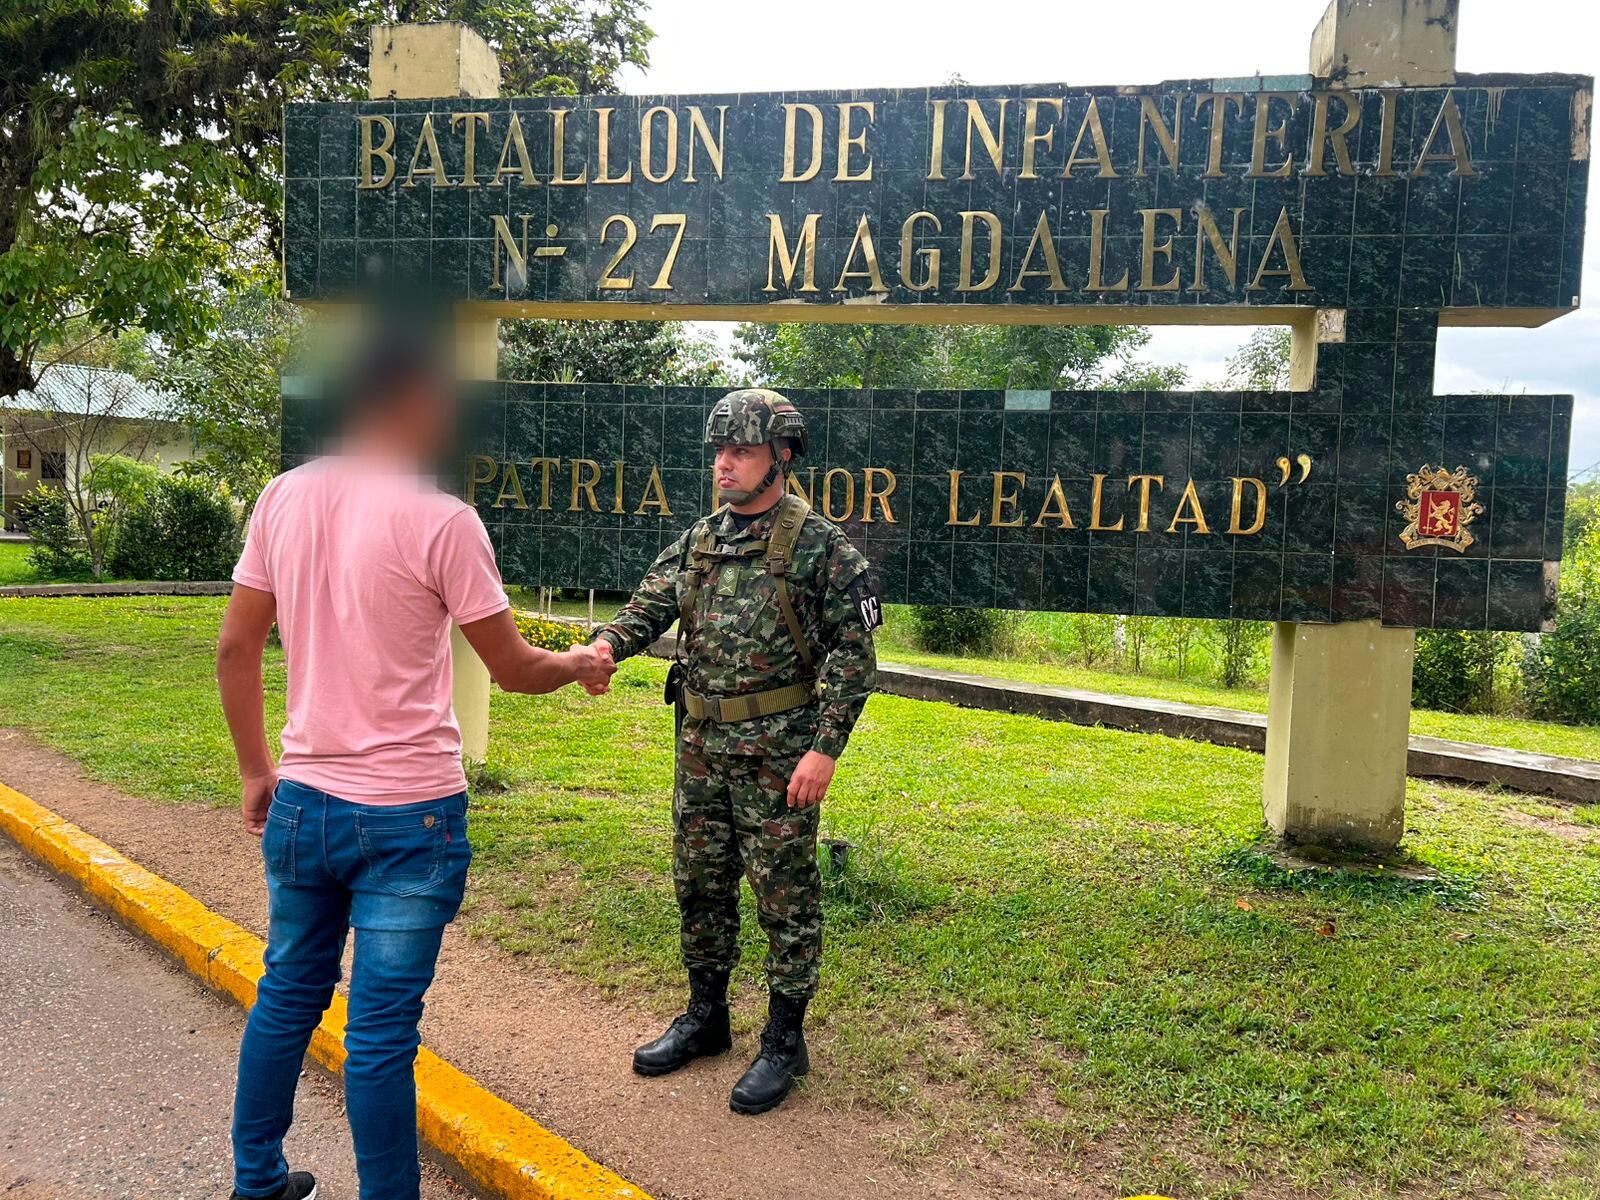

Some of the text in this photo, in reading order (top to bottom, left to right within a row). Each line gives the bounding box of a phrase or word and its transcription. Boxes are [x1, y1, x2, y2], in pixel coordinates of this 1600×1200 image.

[356, 87, 1480, 190] BATALLON DE INFANTERIA
[598, 213, 687, 290] 27
[762, 206, 1317, 294] MAGDALENA
[464, 454, 674, 517] PATRIA
[710, 464, 900, 525] NOR
